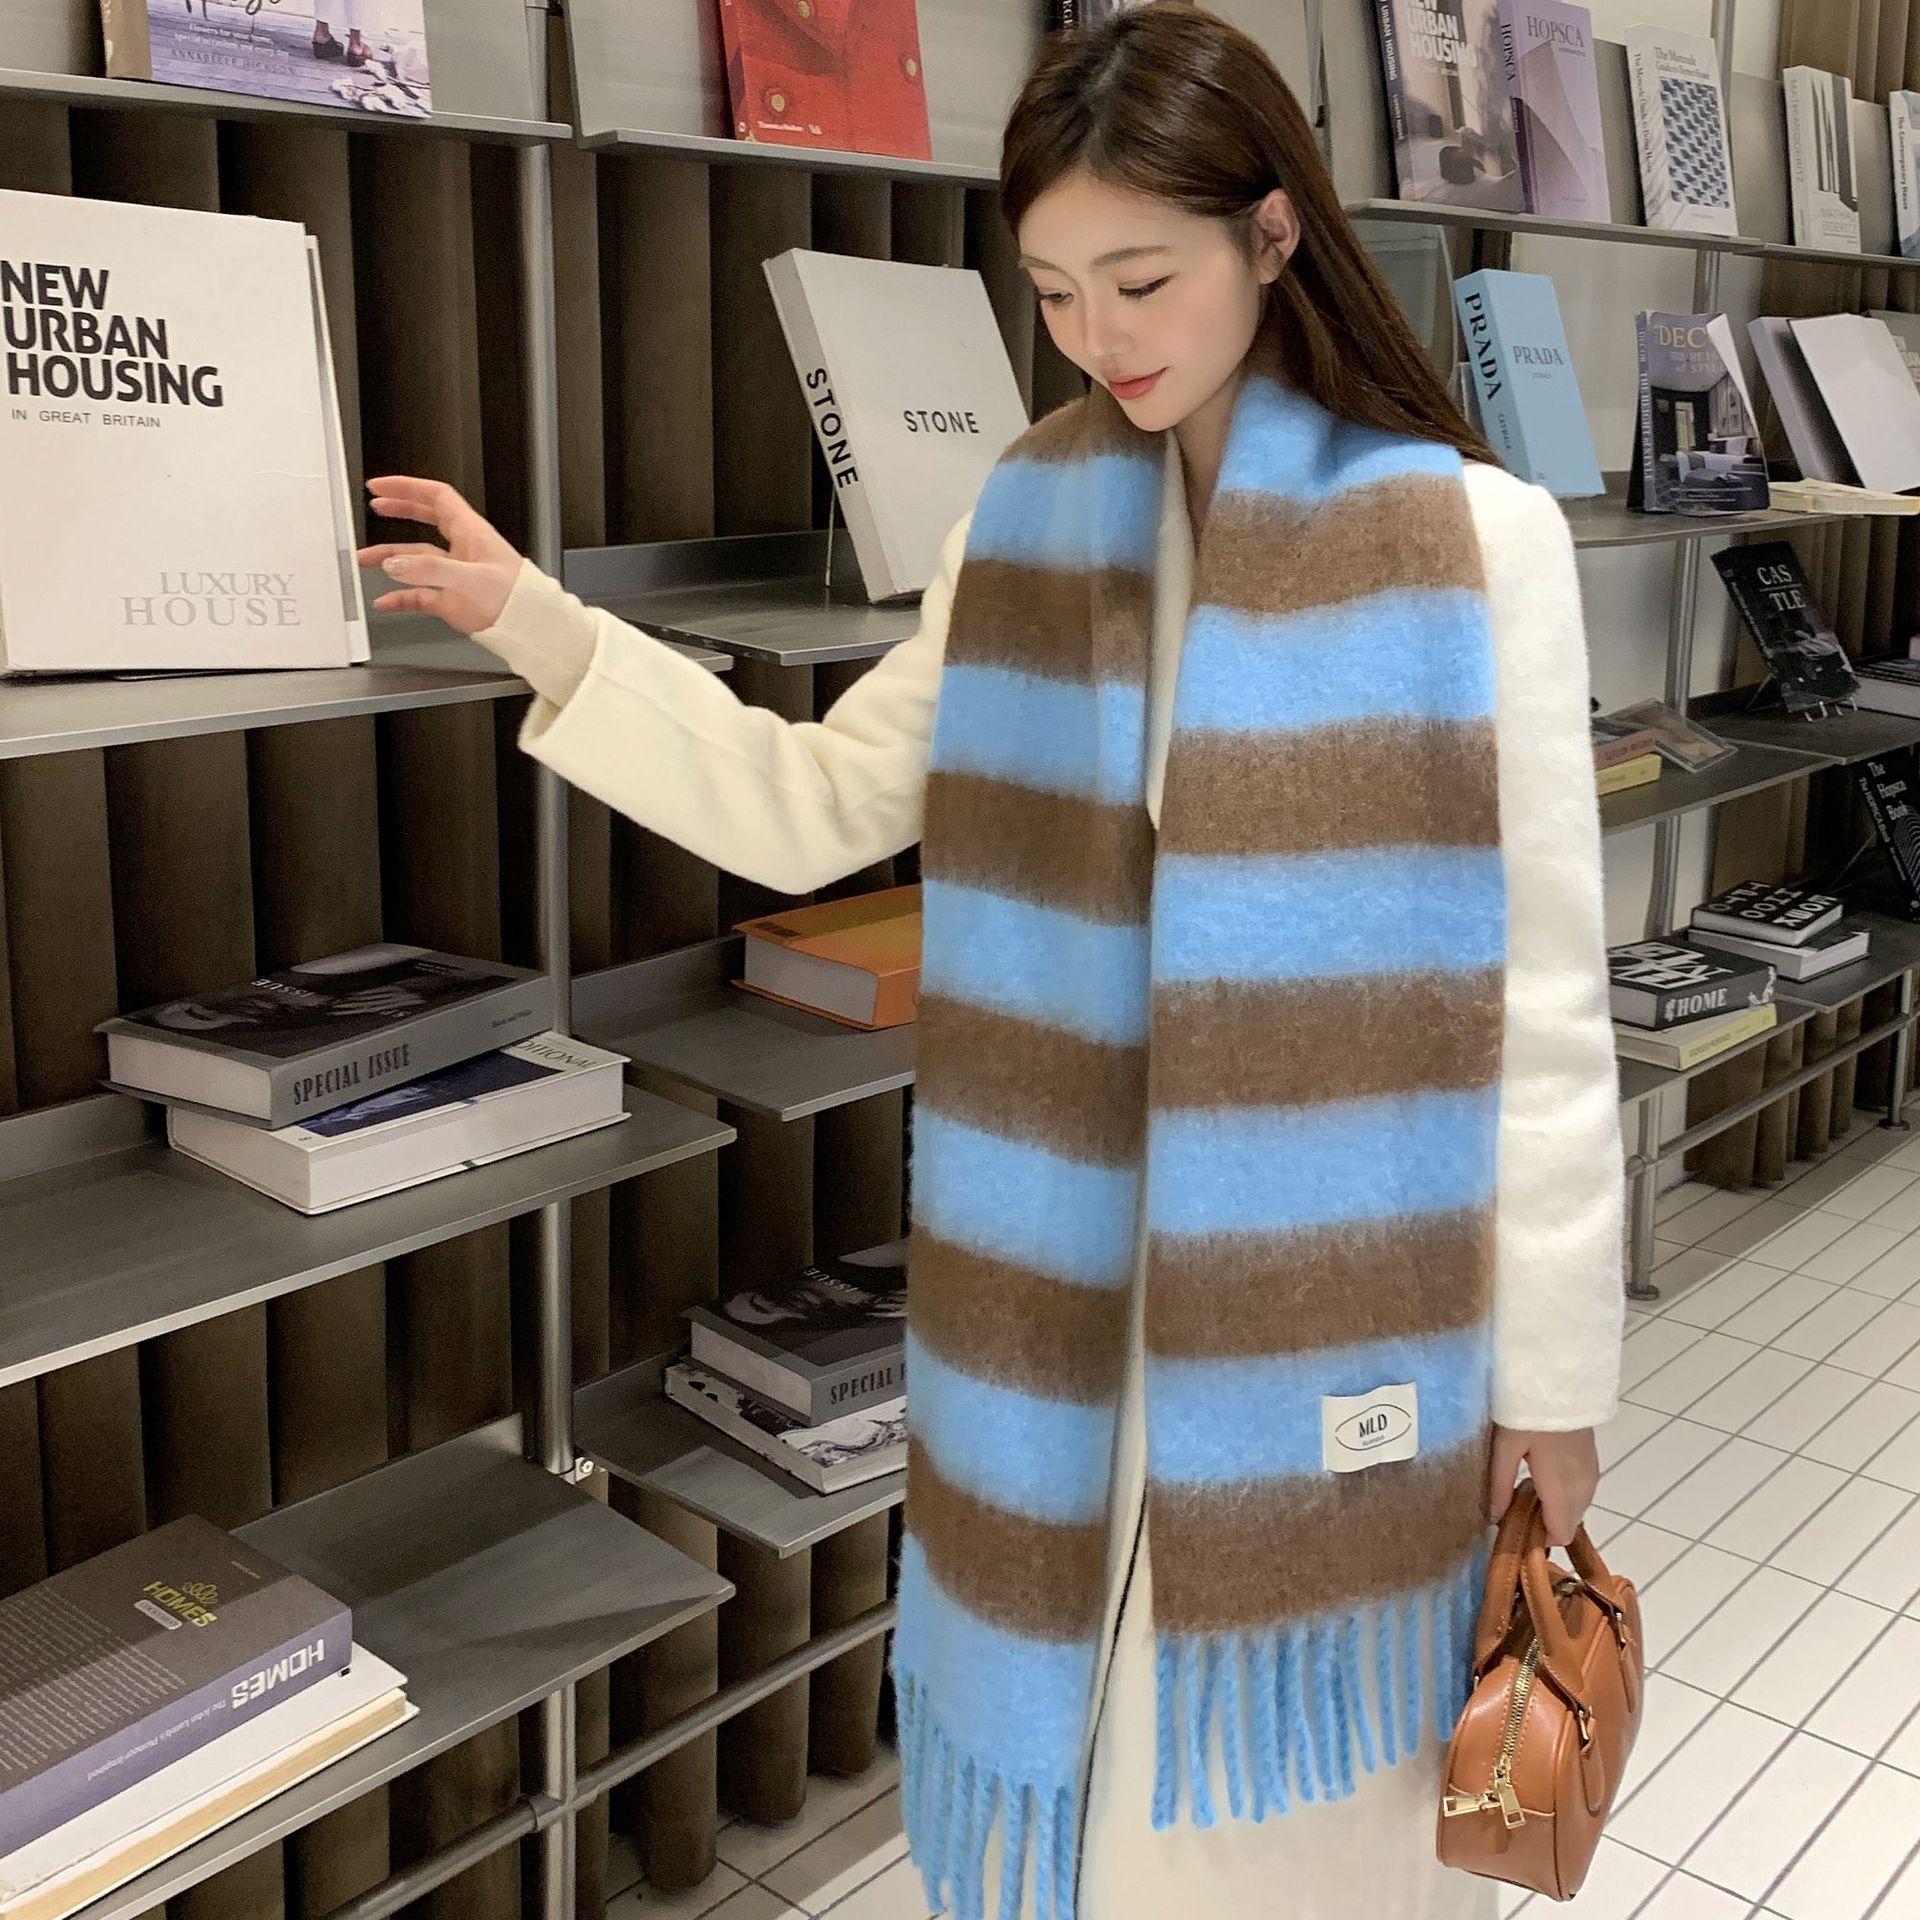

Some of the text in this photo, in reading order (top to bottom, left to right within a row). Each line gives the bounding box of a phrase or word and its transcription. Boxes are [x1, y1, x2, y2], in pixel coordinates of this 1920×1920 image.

[1406, 8, 1460, 39] URBAN
[1527, 16, 1585, 48] HOPSCA
[1500, 23, 1517, 82] HOPSCA
[0, 259, 110, 310] NEW
[3, 305, 169, 360] URBAN
[1464, 292, 1502, 401] PRADA
[1659, 324, 1711, 349] DEC
[1513, 345, 1565, 366] PRADA
[6, 352, 224, 408] HOUSING
[12, 409, 161, 428] IN GREAT BRITAIN
[806, 368, 859, 489] STONE
[903, 410, 980, 434] STONE
[159, 572, 295, 595] LUXURY
[1757, 564, 1793, 585] CAS
[120, 597, 301, 626] HOUSE
[1769, 590, 1806, 611] TLE
[1867, 762, 1887, 777] The
[1676, 988, 1728, 1018] HOME
[516, 1040, 597, 1067] DITIONAL
[293, 1043, 411, 1105] SPECIAL ISSUE
[830, 1367, 894, 1405] SPECIAL
[1358, 1413, 1388, 1438] MLD
[142, 1580, 218, 1627] HOMES
[230, 1638, 325, 1710] HOMES
